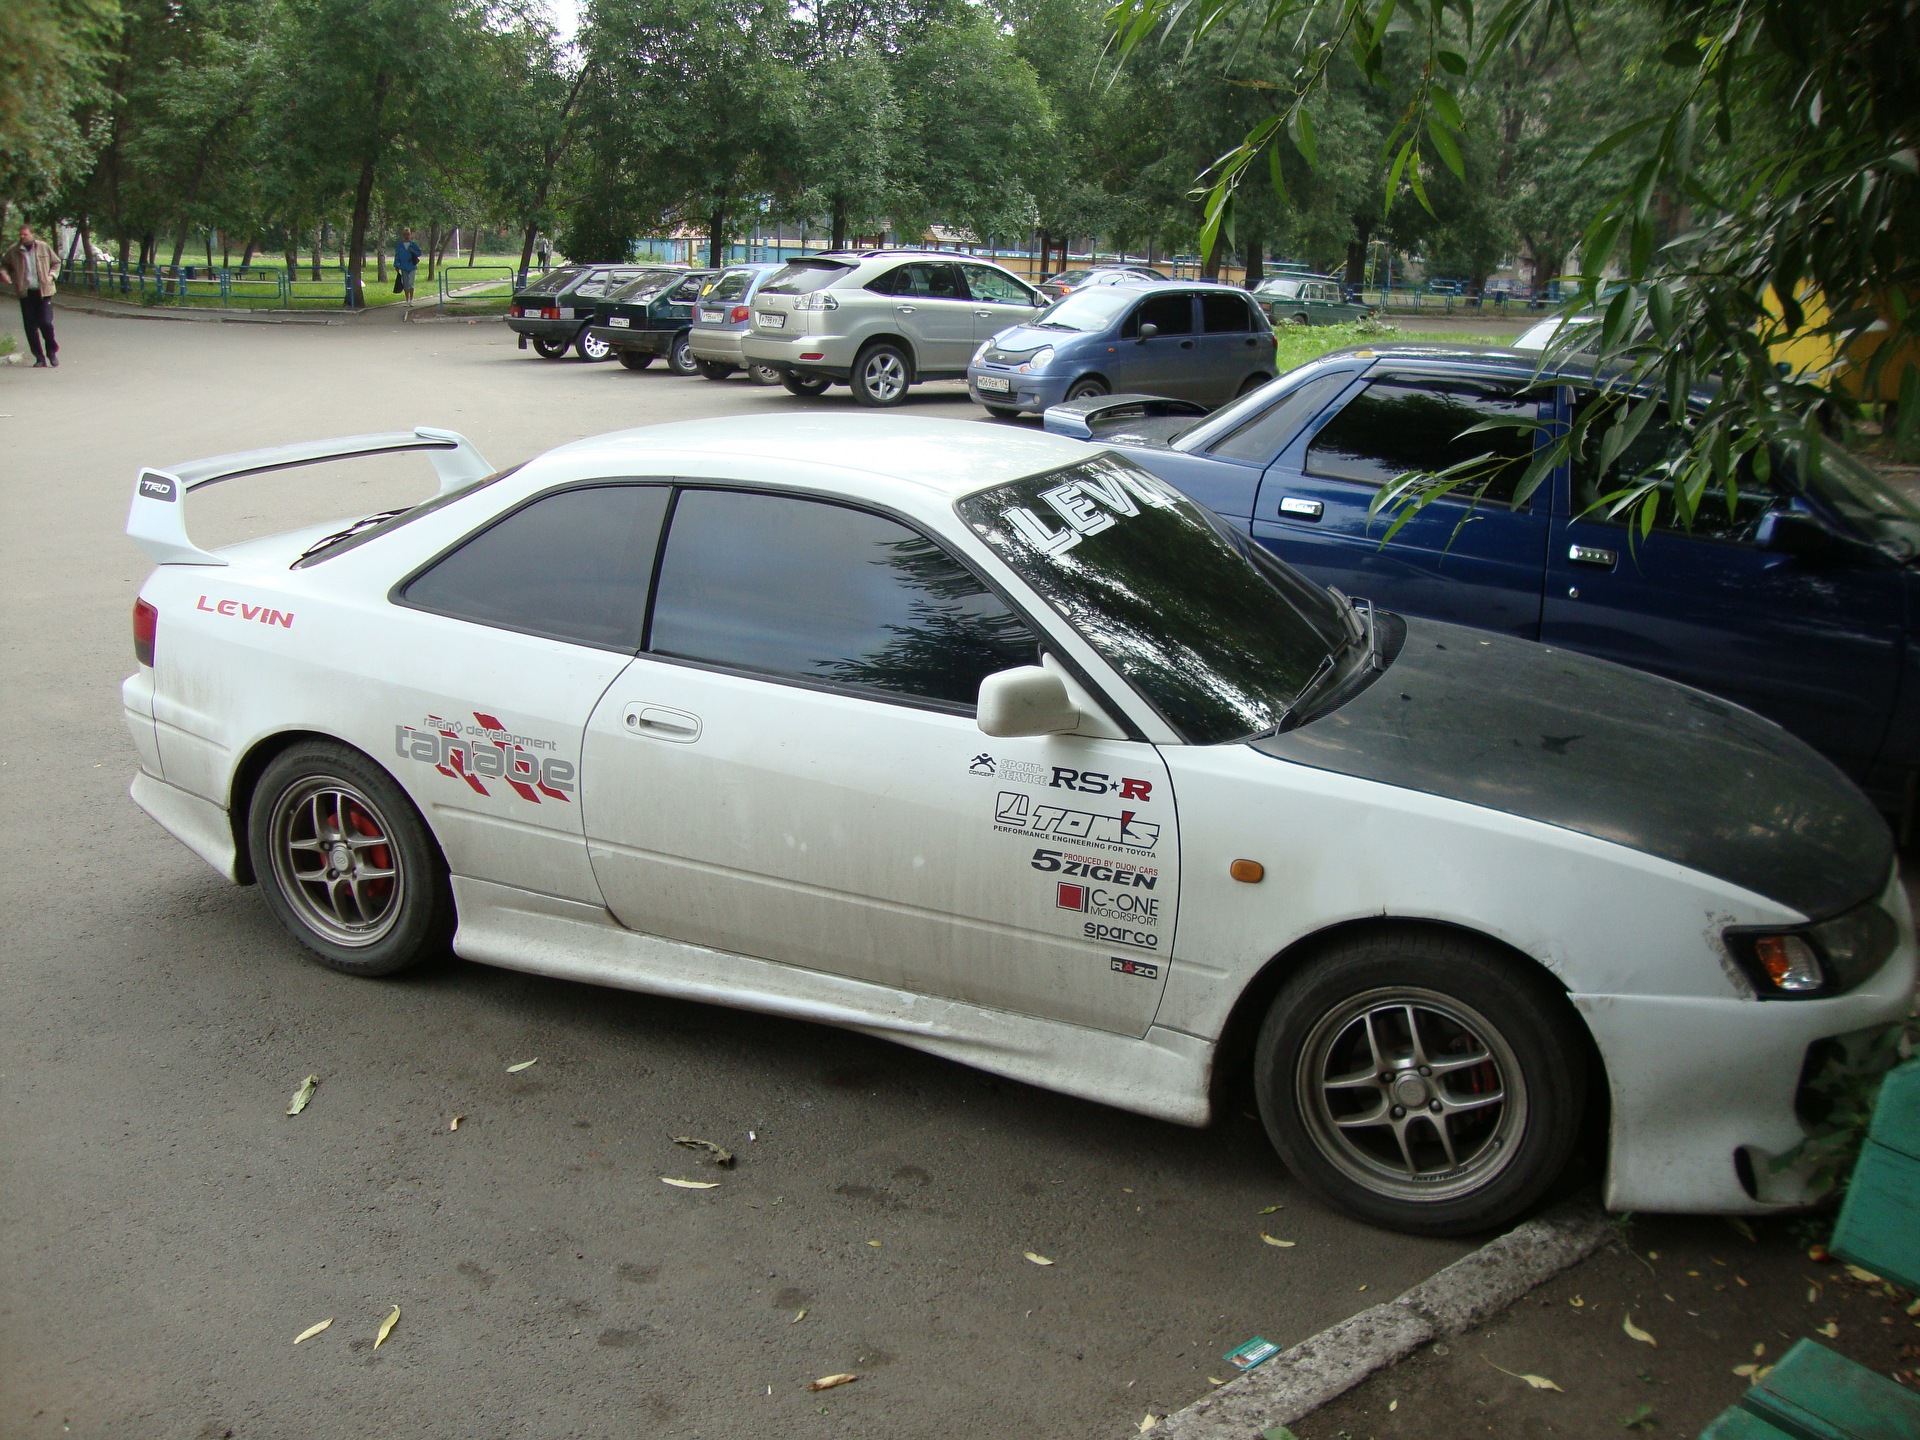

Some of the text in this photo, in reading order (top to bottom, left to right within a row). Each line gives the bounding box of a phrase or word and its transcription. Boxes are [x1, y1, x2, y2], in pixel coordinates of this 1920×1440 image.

[142, 480, 171, 494] TRD
[197, 596, 295, 629] LEVIN
[466, 725, 557, 751] development
[395, 724, 575, 792] tanabe
[968, 769, 996, 778] CONCEPT
[998, 769, 1048, 786] SERVICE
[993, 825, 1157, 859] PERFORMANCE ENGINEERING FOR TOYOTA
[1031, 848, 1158, 890] 5ZIGEN
[1063, 853, 1102, 866] PRODUCED
[1104, 859, 1114, 867] BY
[1139, 866, 1159, 876] CARS
[1090, 906, 1158, 926] MOTORSPORT
[1083, 921, 1158, 947] sparco
